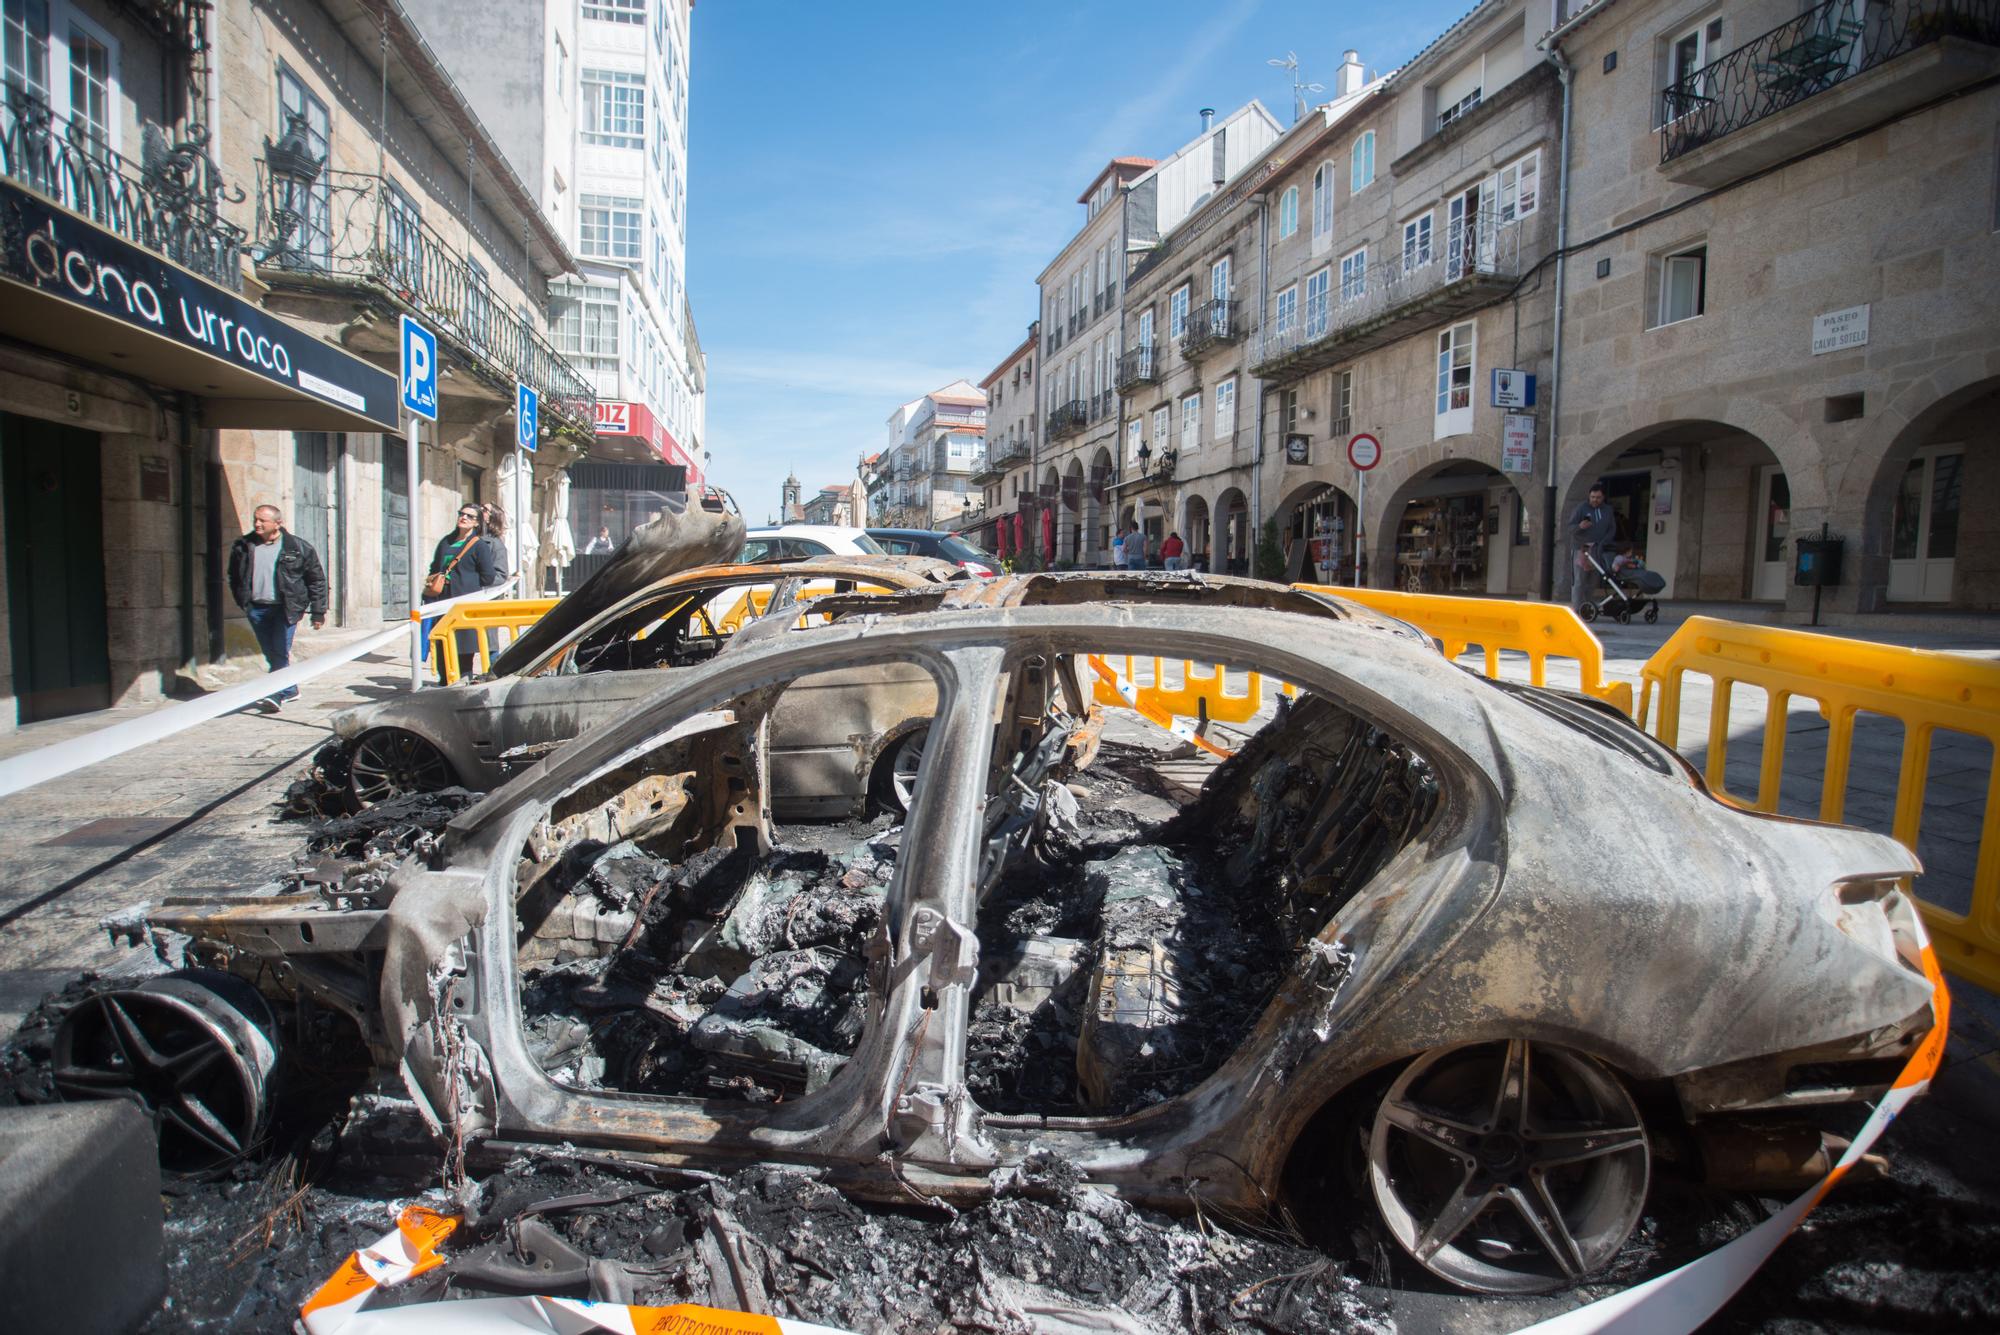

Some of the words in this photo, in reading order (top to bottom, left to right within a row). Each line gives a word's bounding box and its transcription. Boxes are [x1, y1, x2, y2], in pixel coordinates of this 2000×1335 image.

[1824, 312, 1858, 327] PASEO
[1832, 324, 1849, 334] DE
[180, 297, 293, 378] urraca
[1813, 336, 1836, 351] CALVO
[1839, 330, 1867, 345] SOTELO
[68, 392, 80, 412] 5
